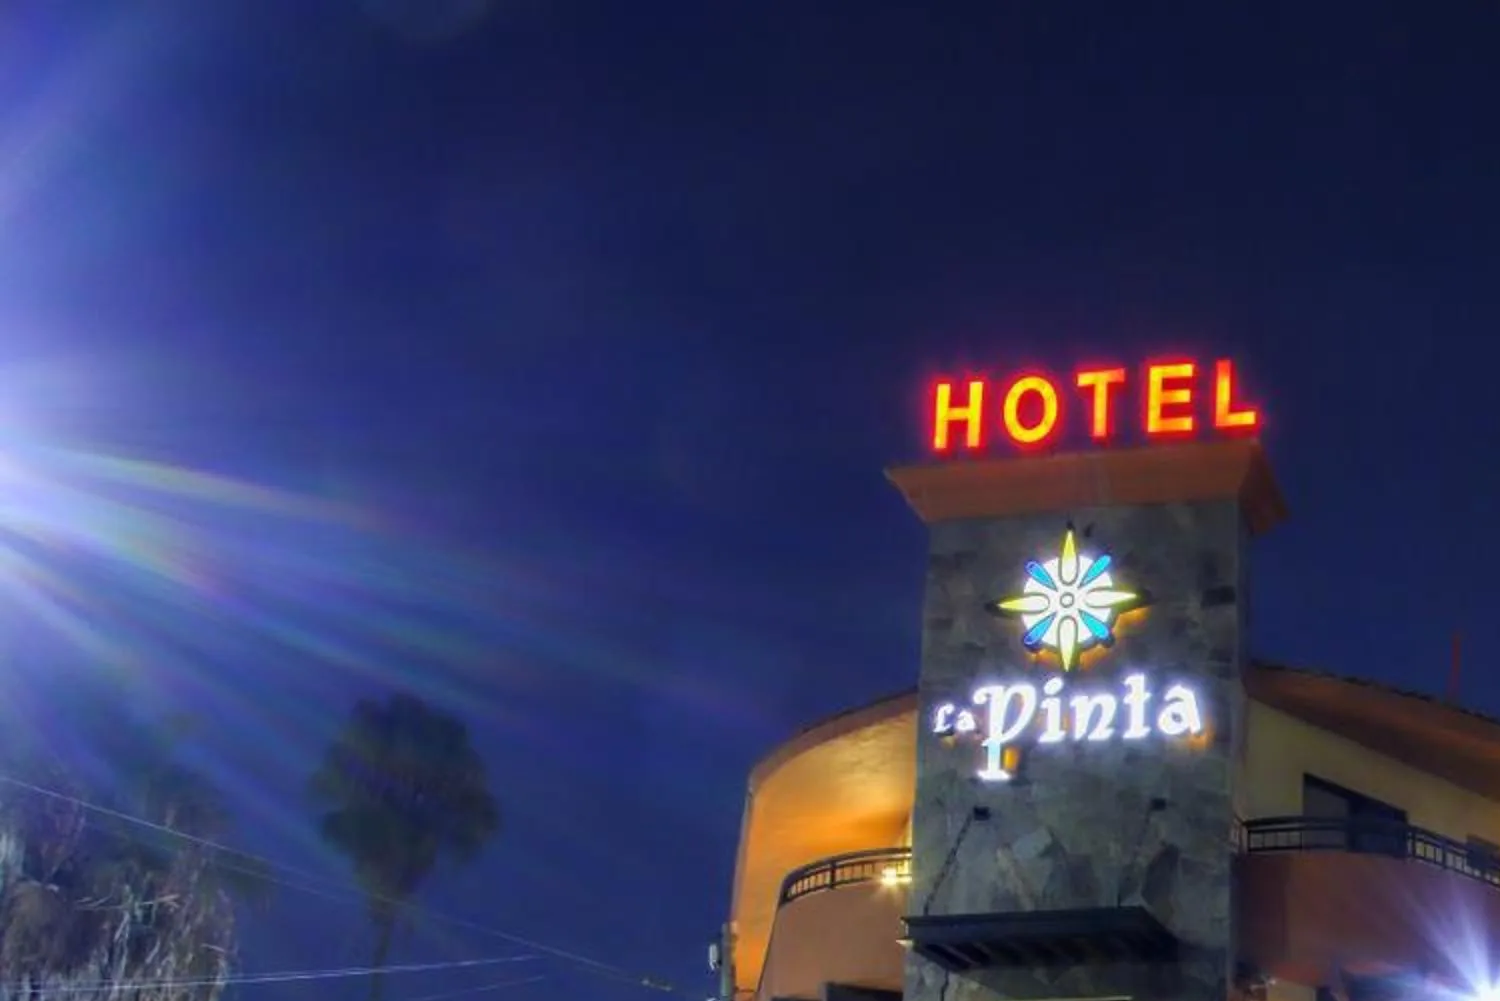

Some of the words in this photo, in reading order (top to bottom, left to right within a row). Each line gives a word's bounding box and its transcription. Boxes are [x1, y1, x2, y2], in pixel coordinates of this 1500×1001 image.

[930, 358, 1259, 451] HOTEL
[932, 703, 977, 734] La
[972, 673, 1203, 781] Pinta
